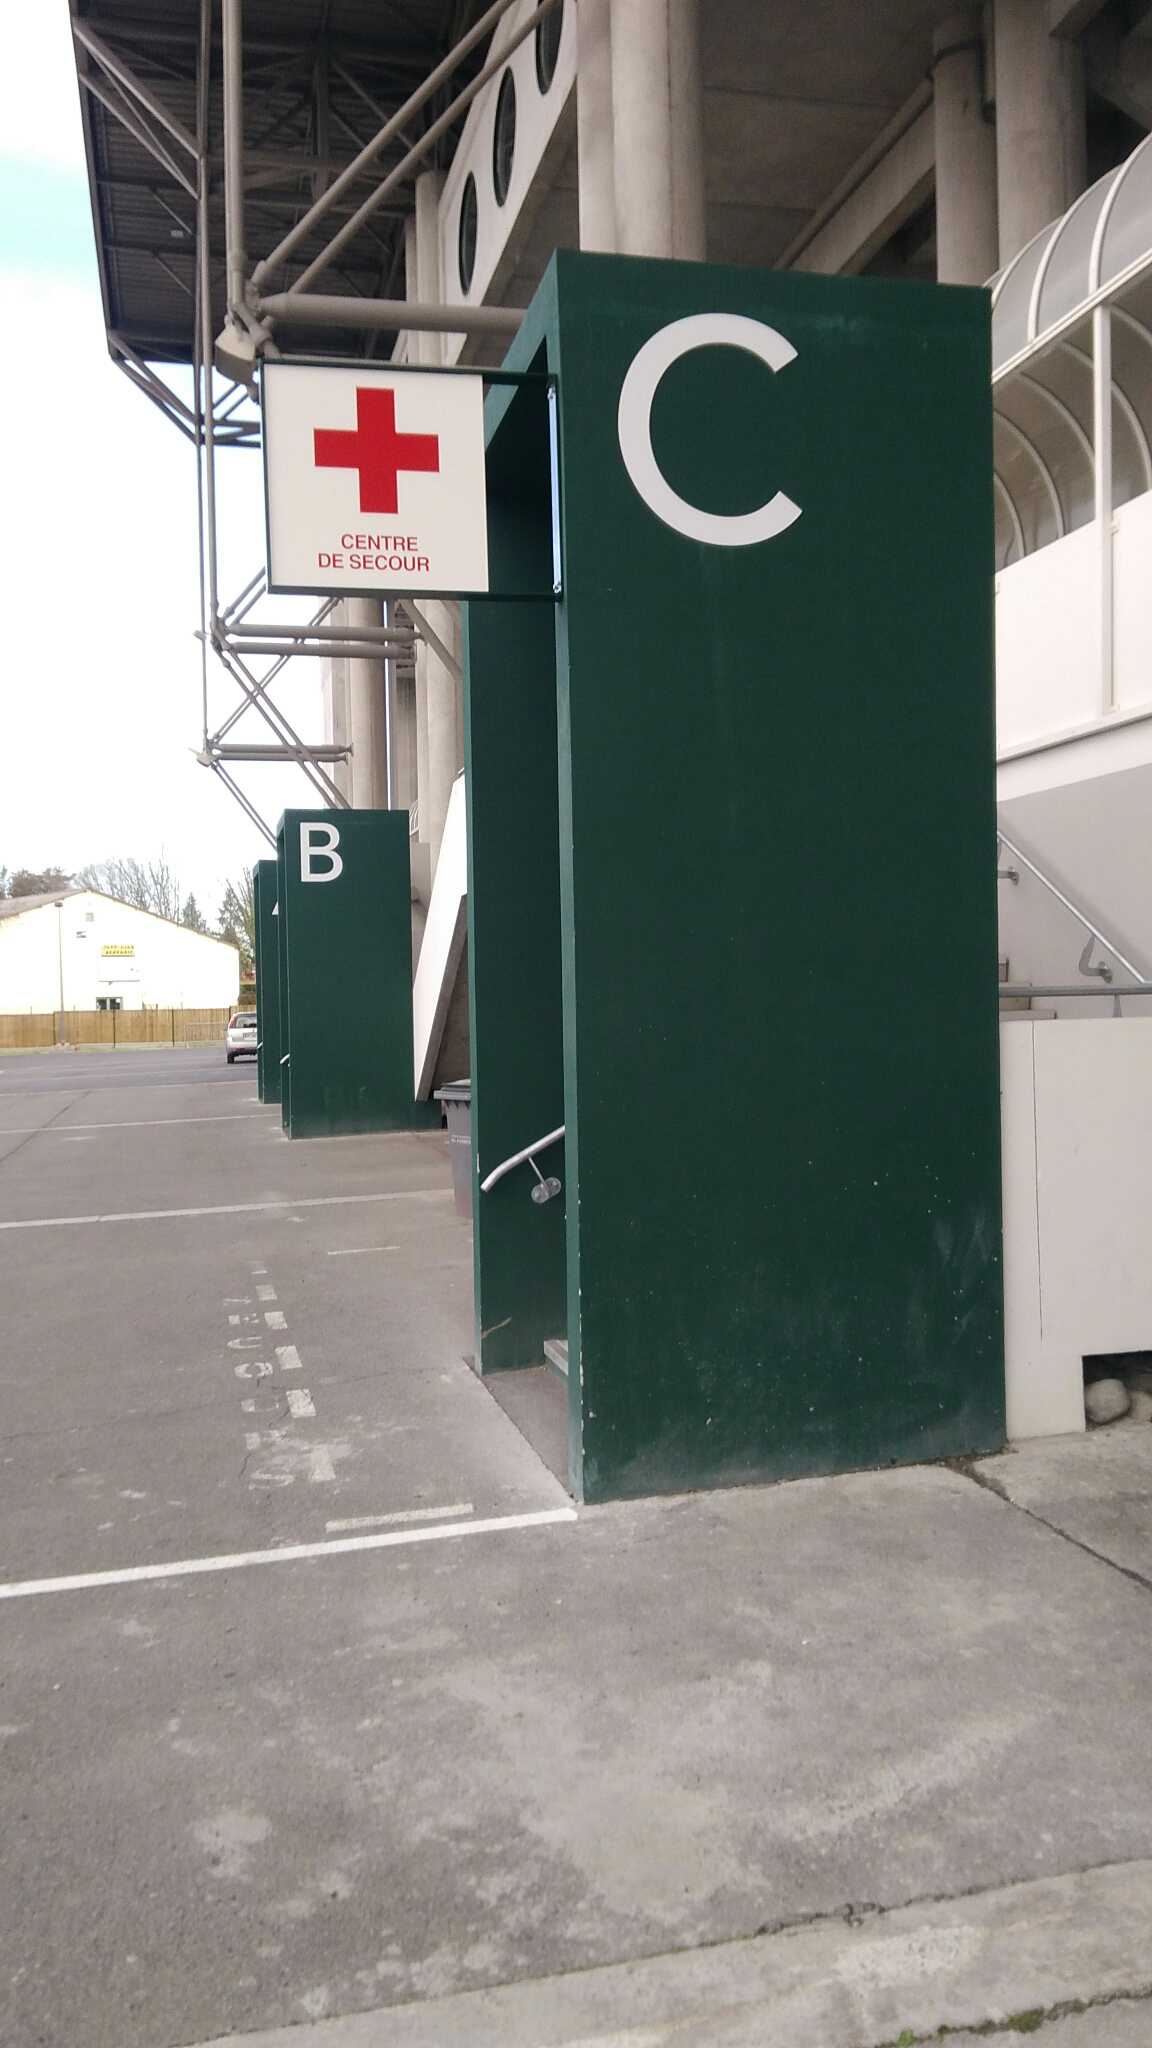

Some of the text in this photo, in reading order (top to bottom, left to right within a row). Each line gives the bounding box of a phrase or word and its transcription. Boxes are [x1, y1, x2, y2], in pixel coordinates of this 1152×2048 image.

[618, 313, 802, 547] C
[318, 552, 430, 572] DE SECOUR
[341, 533, 419, 552] CENTRE
[300, 822, 343, 882] B
